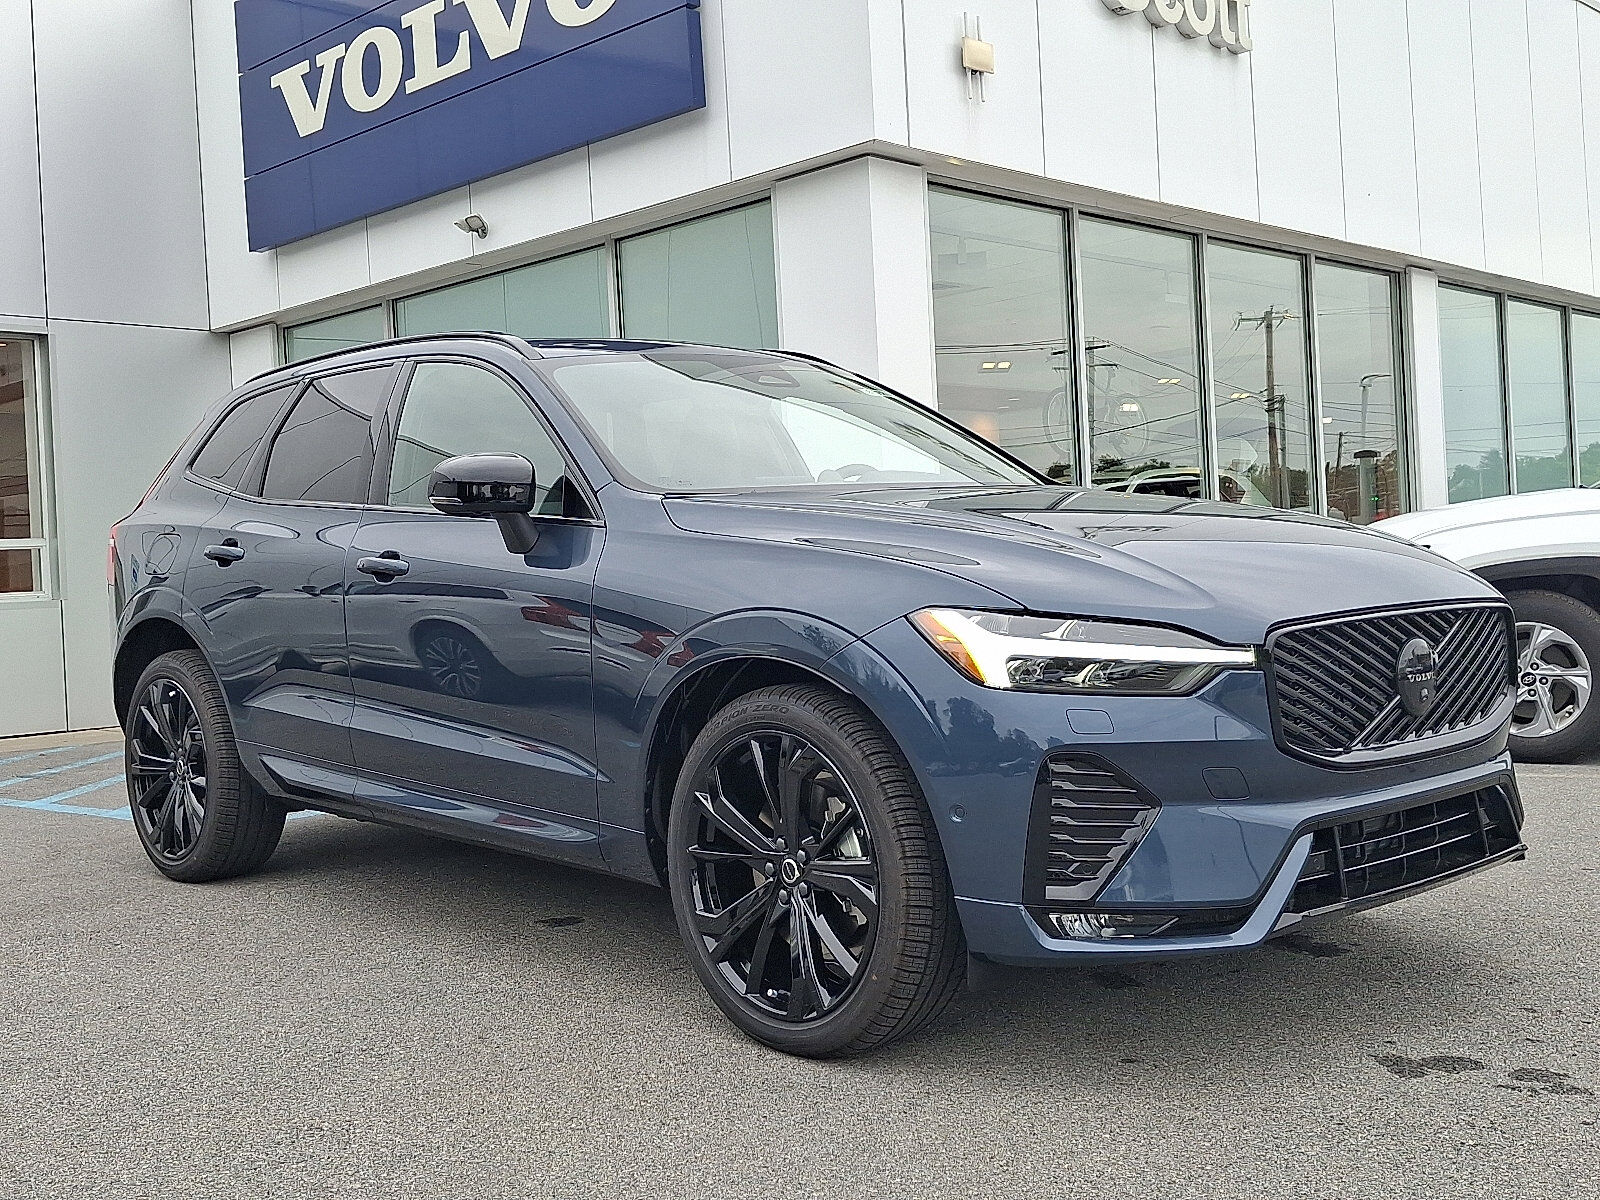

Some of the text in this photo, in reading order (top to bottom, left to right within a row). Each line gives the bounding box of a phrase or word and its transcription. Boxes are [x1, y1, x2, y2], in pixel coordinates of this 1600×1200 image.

[1106, 0, 1253, 52] cott
[271, 0, 616, 137] VOLV
[752, 704, 789, 714] ZERO
